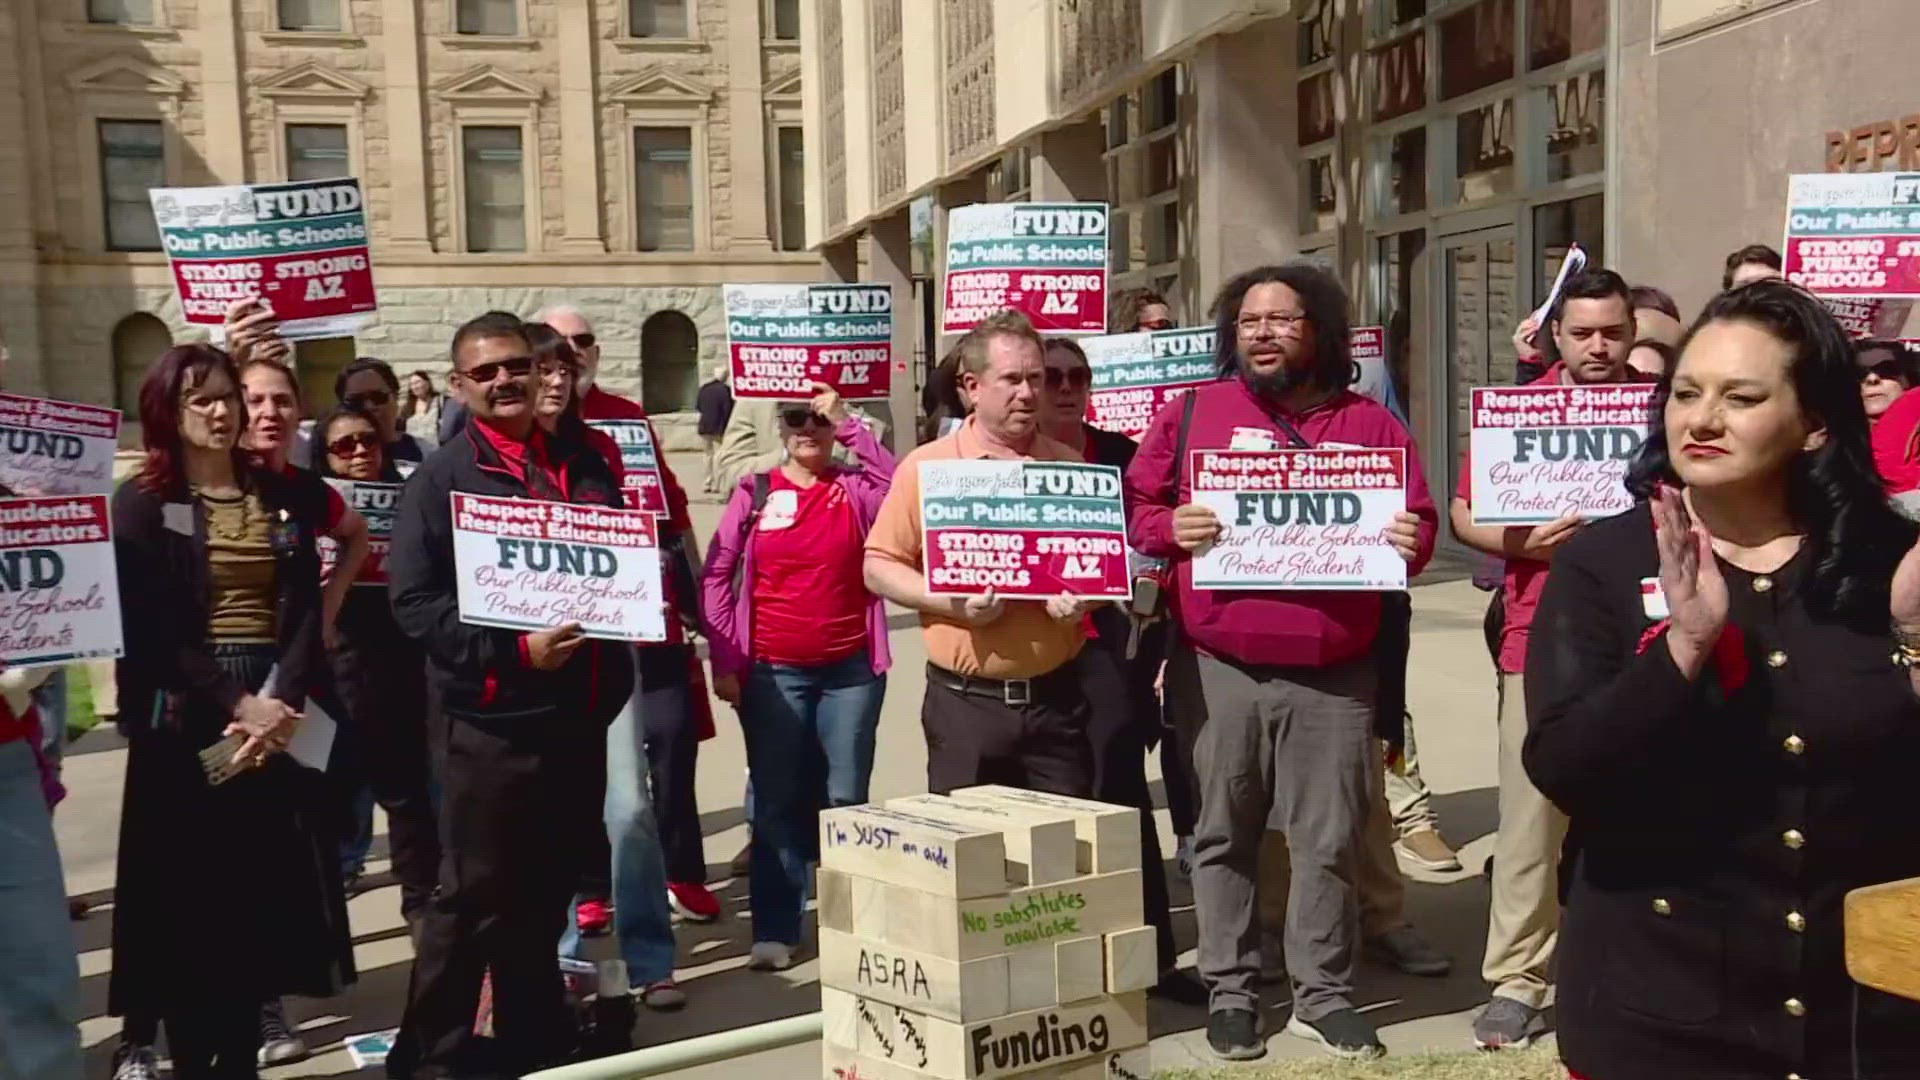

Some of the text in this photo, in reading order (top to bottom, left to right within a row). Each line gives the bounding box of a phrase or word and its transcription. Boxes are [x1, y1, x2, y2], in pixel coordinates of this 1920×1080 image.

[254, 185, 361, 220] FUND
[1014, 209, 1105, 235] FUND
[1791, 213, 1833, 230] Our
[1835, 210, 1905, 230] Public
[166, 222, 365, 251] Our Public Schools
[1798, 239, 1885, 256] STRONG
[973, 242, 1023, 263] Public
[1027, 243, 1105, 261] Schools
[1801, 255, 1880, 272] PUBLIC
[179, 254, 367, 281] STRONG STRONG
[188, 281, 261, 299] PUBLIC
[304, 276, 347, 301] AZ
[951, 273, 1100, 291] STRONG STRONG
[810, 290, 890, 313] FUND
[952, 289, 1007, 306] PUBLIC
[1041, 293, 1079, 314] AZ
[730, 320, 890, 337] Our Public Schools
[739, 347, 888, 364] STRONG STRONG
[743, 363, 806, 378] PUBLIC
[838, 365, 870, 384] AZ
[1093, 361, 1216, 384] ur Public Schoo
[735, 377, 813, 392] SCHOOLS
[1091, 389, 1155, 406] STRONG
[1482, 389, 1650, 412] Respect Studen
[1095, 402, 1153, 418] PUBLIC
[1478, 408, 1561, 428] Respect
[1513, 428, 1641, 462] FUND
[1203, 454, 1288, 474] Respect
[1489, 461, 1527, 486] Our
[1531, 460, 1593, 485] Public
[1024, 468, 1119, 496] FUND
[1199, 471, 1283, 491] Respect
[462, 496, 545, 521] Respect
[1235, 492, 1362, 526] FUND
[1498, 489, 1562, 513] Protect
[459, 512, 543, 537] Respect
[926, 502, 1122, 525] Our Public Schools
[938, 533, 1121, 555] STRONG STRONG
[1216, 524, 1251, 548] Our
[1253, 523, 1315, 548] Public
[496, 537, 618, 578] FUND
[943, 551, 1021, 568] PUBLIC
[1062, 556, 1101, 578] AZ
[1219, 551, 1364, 584] Protect Students
[0, 548, 64, 592] ND
[931, 568, 1031, 586] SCHOOLS
[475, 565, 649, 606] Our Public Schools
[13, 583, 105, 630] Schools
[485, 591, 624, 627] Protect Students
[826, 822, 949, 870] I'm JUST an aide
[962, 911, 987, 933] No
[857, 947, 932, 1000] ASRA
[971, 1013, 1110, 1078] Funding
